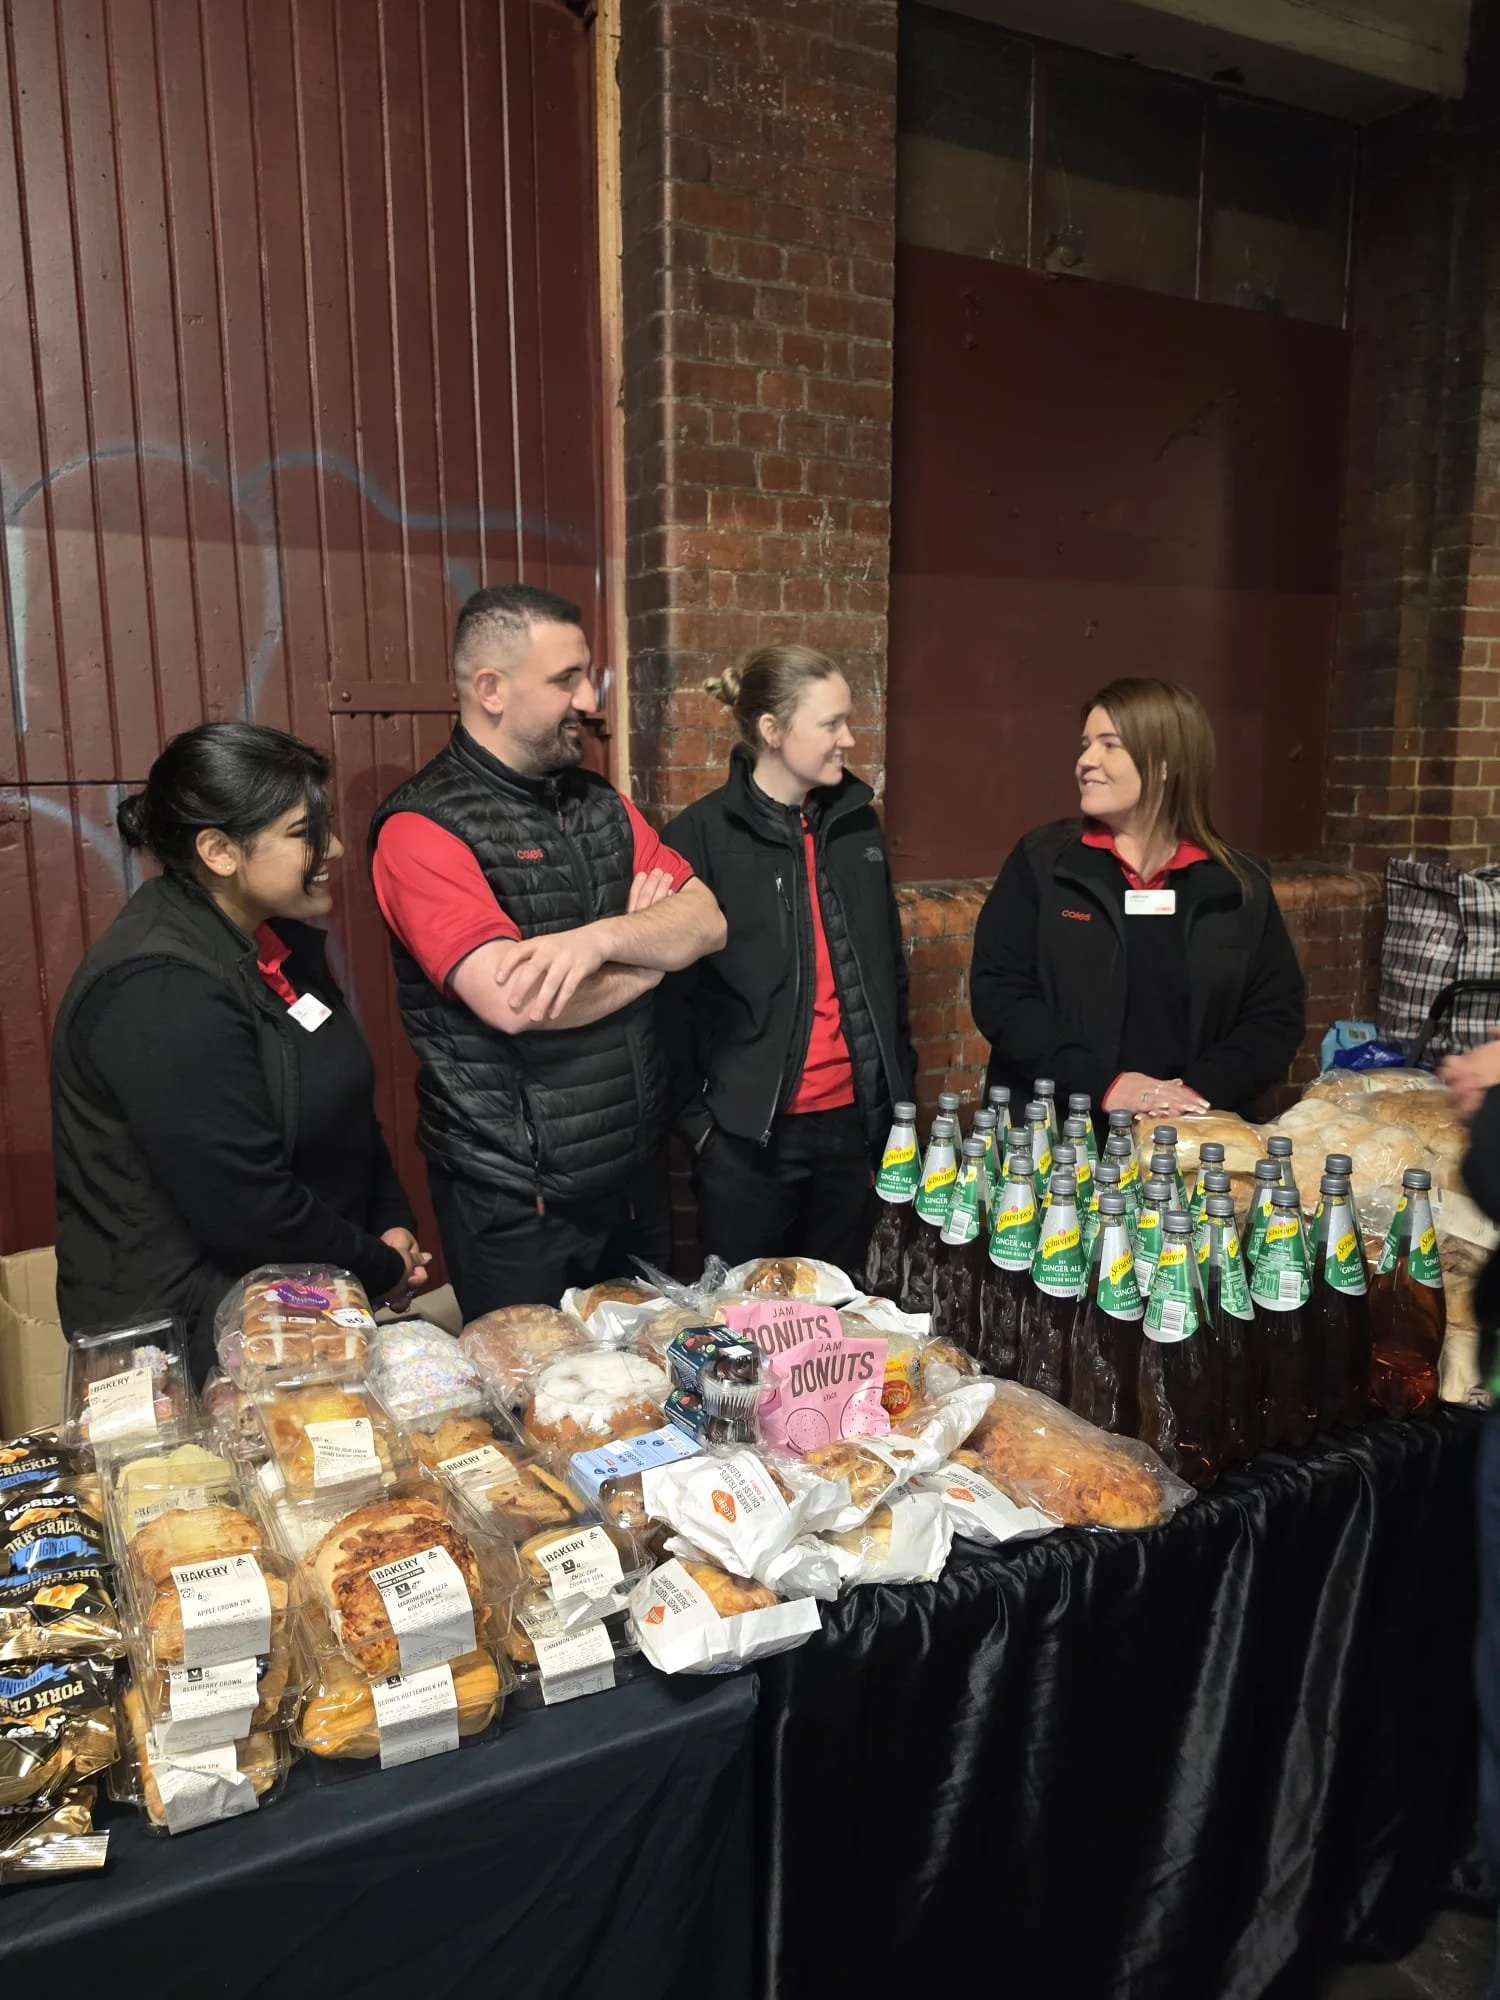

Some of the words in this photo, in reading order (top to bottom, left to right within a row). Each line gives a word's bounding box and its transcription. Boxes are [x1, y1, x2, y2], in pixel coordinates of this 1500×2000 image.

[1062, 909, 1092, 921] coles
[880, 1173, 900, 1182] GINGER
[998, 1209, 1032, 1226] Schweppes
[995, 1238, 1018, 1247] GINGER
[1020, 1240, 1032, 1249] ALE
[1043, 1231, 1079, 1253] Schweppes
[1042, 1264, 1069, 1272] GINGER
[1070, 1265, 1081, 1273] ALE
[1112, 1285, 1137, 1298] GINGER
[773, 1306, 794, 1318] JAM
[742, 1314, 832, 1355] DONUTS
[818, 1341, 842, 1353] JAM
[94, 1375, 130, 1393] BAKERY
[790, 1351, 875, 1398] DONUTS
[446, 1454, 480, 1472] BAKERY
[712, 1491, 735, 1521] VEGEMITE
[734, 1490, 753, 1514] BAKERY
[742, 1485, 760, 1508] CHEESE
[4, 1496, 77, 1520] NOBBY'S
[37, 1519, 101, 1540] CRACKLE
[25, 1539, 71, 1562] OIGINAL
[545, 1539, 585, 1563] BAKERY
[68, 1569, 102, 1580] ORK
[180, 1564, 229, 1583] BAKERY
[375, 1557, 420, 1581] BAKERY
[197, 1606, 216, 1617] APPLE
[217, 1602, 239, 1612] CROWN
[0, 1669, 44, 1695] ORIGINA
[182, 1682, 218, 1693] BLUEBERRY
[219, 1678, 242, 1688] CROWN
[36, 1680, 85, 1710] PORK
